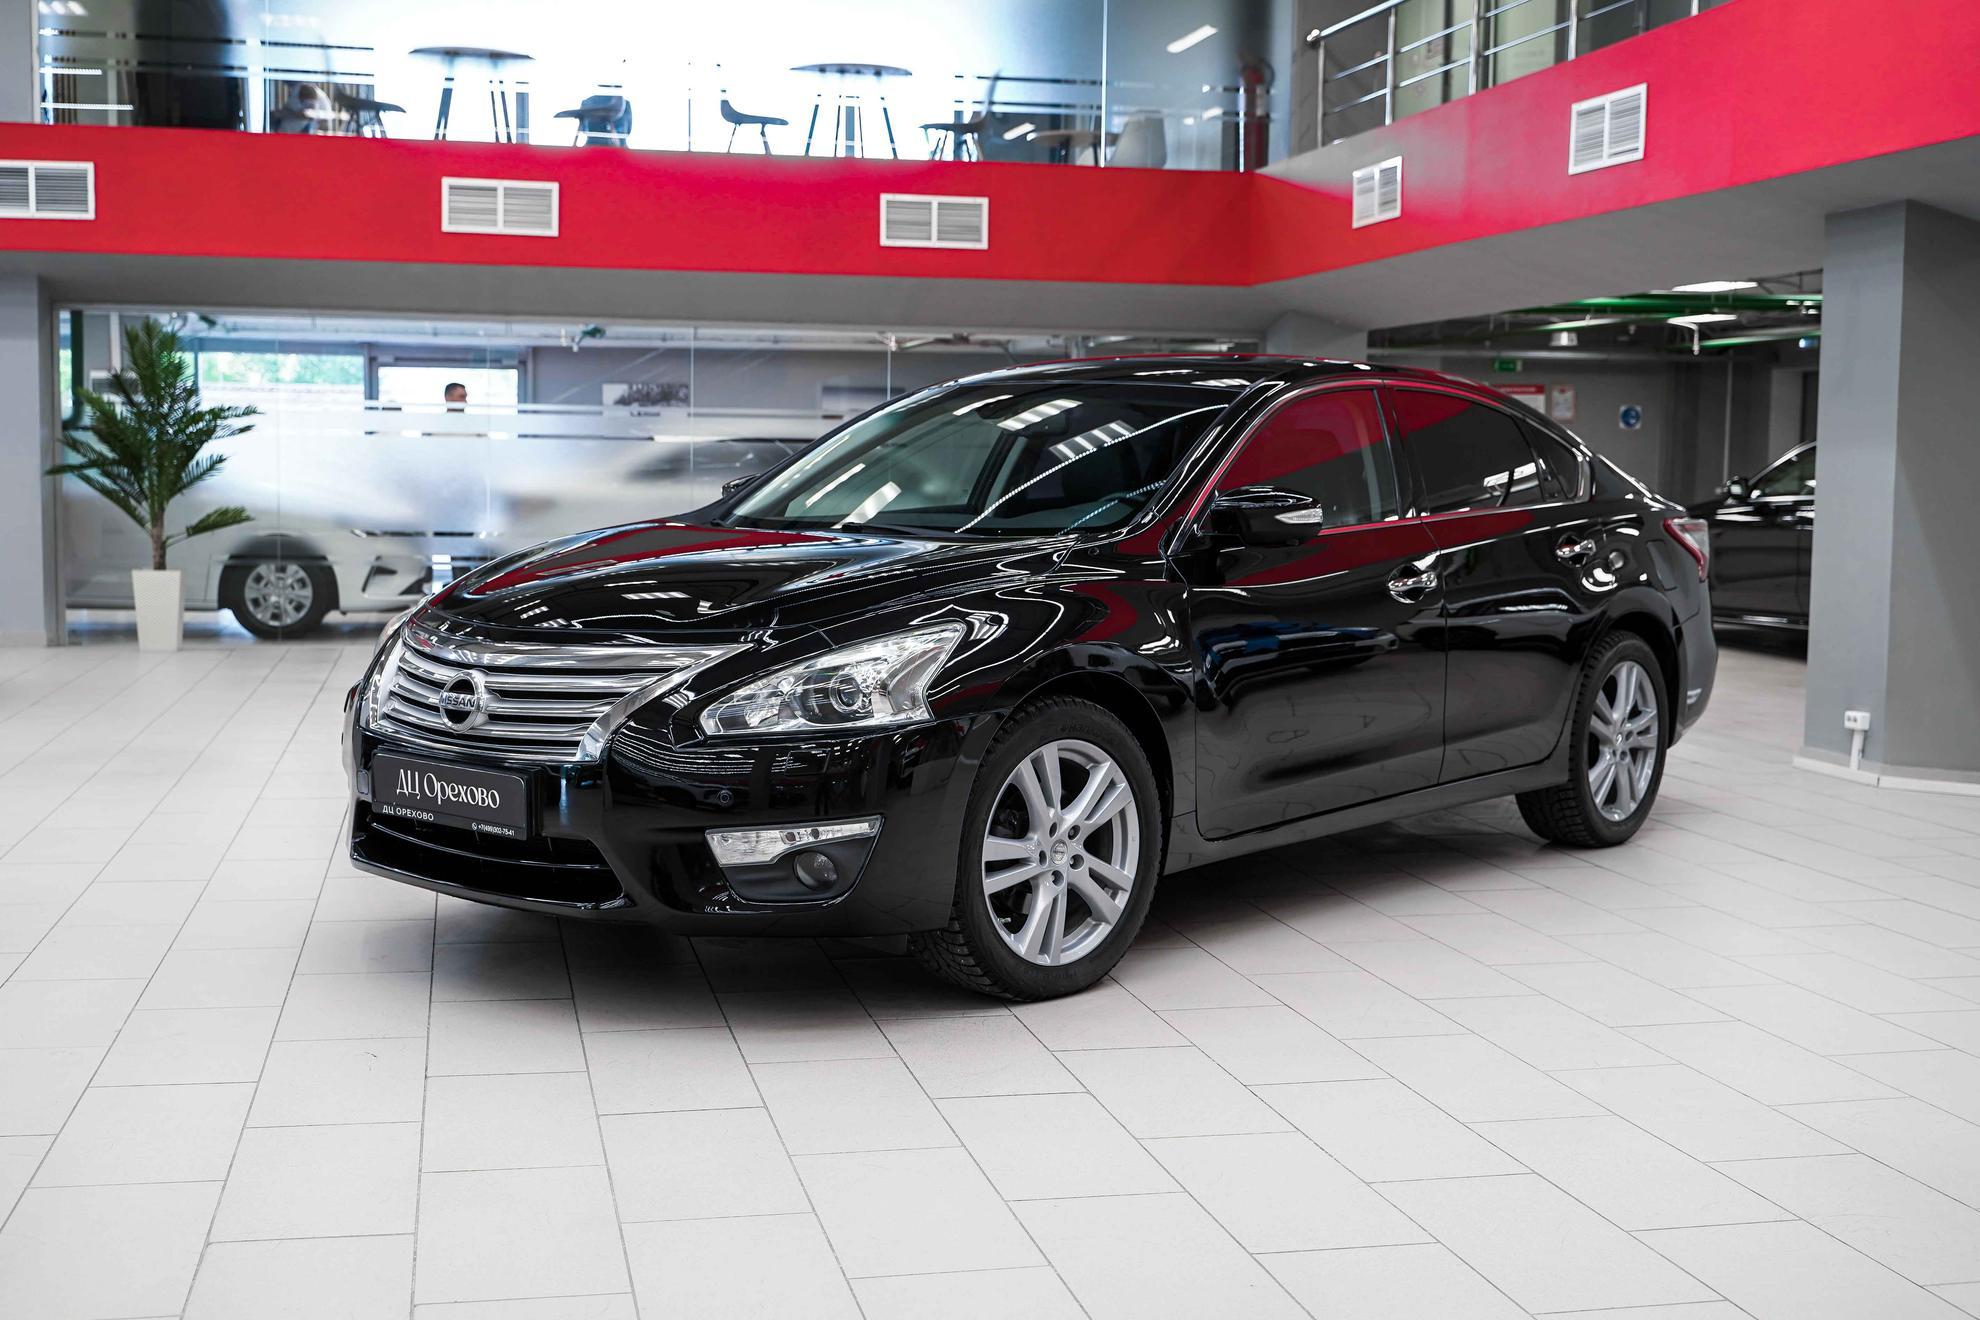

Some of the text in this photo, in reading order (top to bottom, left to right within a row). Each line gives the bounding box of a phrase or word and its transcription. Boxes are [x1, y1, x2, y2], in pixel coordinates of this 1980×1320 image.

[440, 692, 476, 708] NISSAN
[396, 768, 500, 809] ДЦ Орехово
[382, 805, 434, 821] ДЦ ОРЕХОВО
